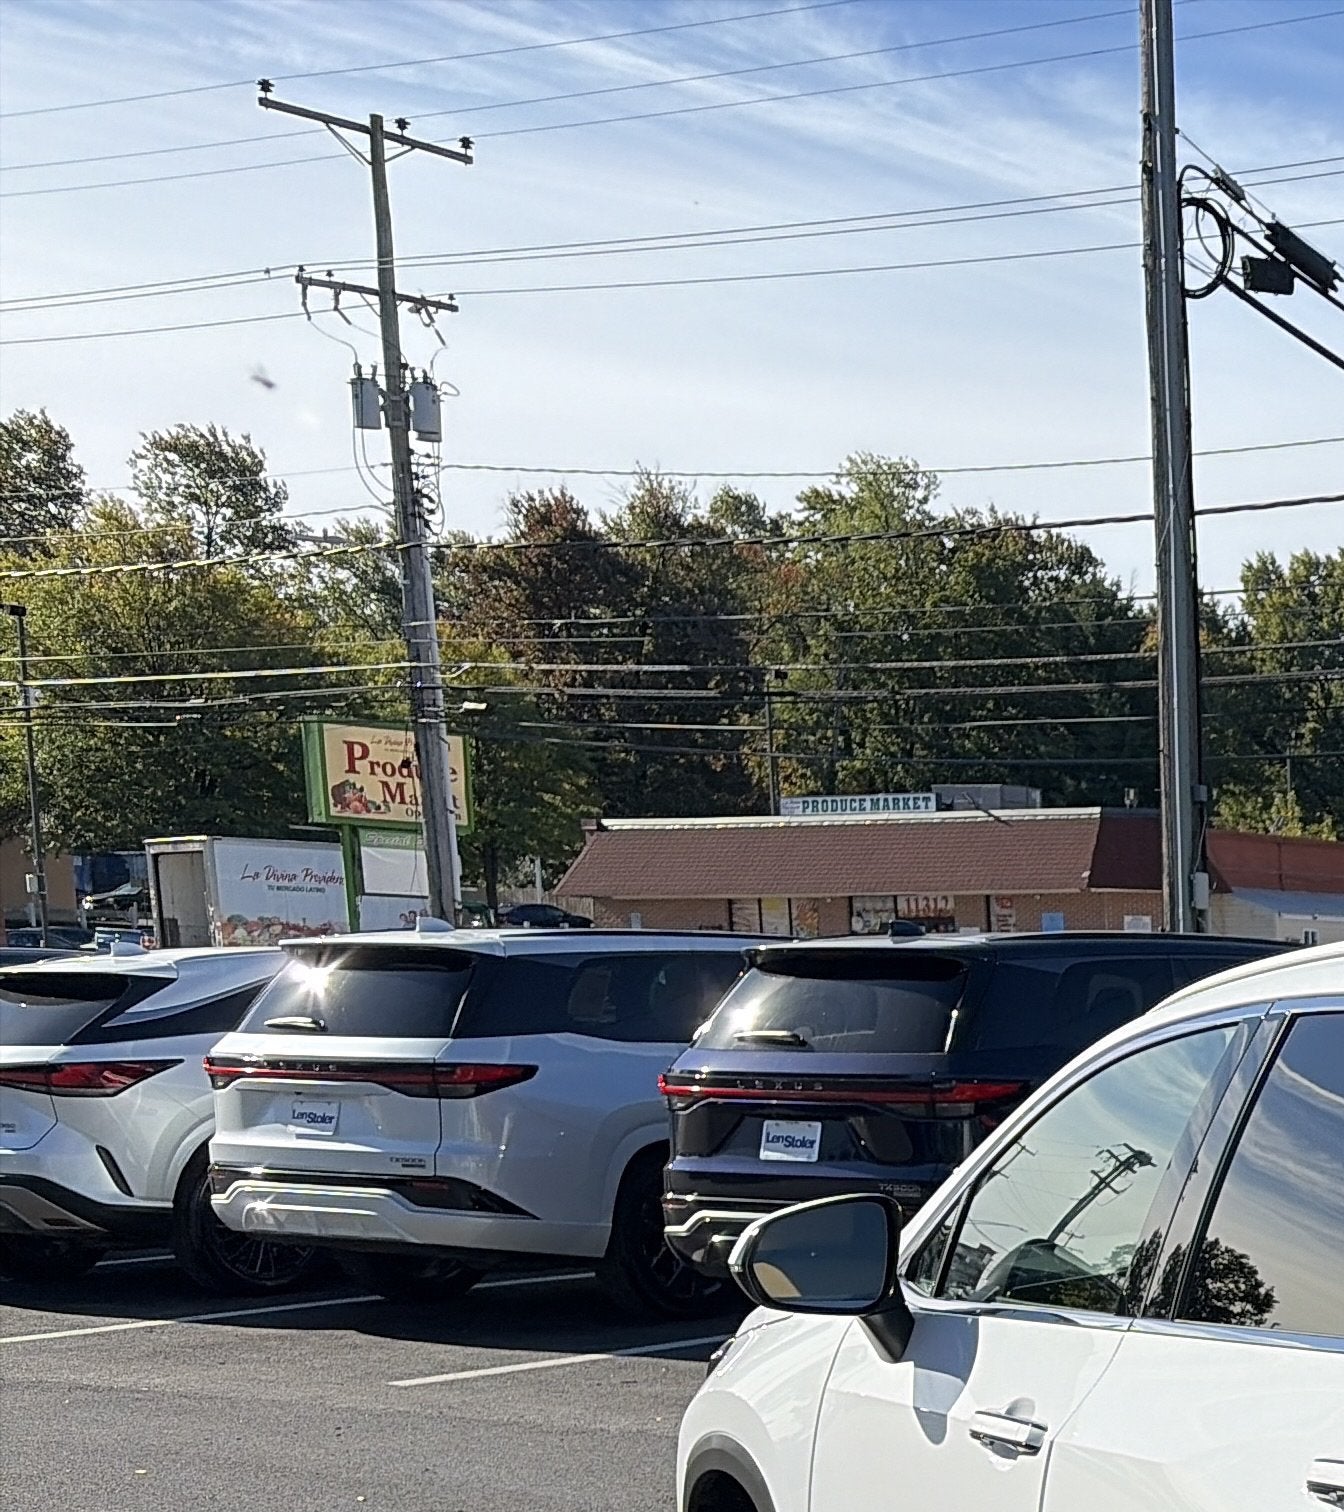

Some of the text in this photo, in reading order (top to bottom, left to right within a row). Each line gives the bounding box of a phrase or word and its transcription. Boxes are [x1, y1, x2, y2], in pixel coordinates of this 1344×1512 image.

[801, 797, 867, 813] PRODUCE
[869, 795, 932, 812] MARKET
[240, 863, 260, 881] La
[736, 1079, 823, 1090] LEXUS
